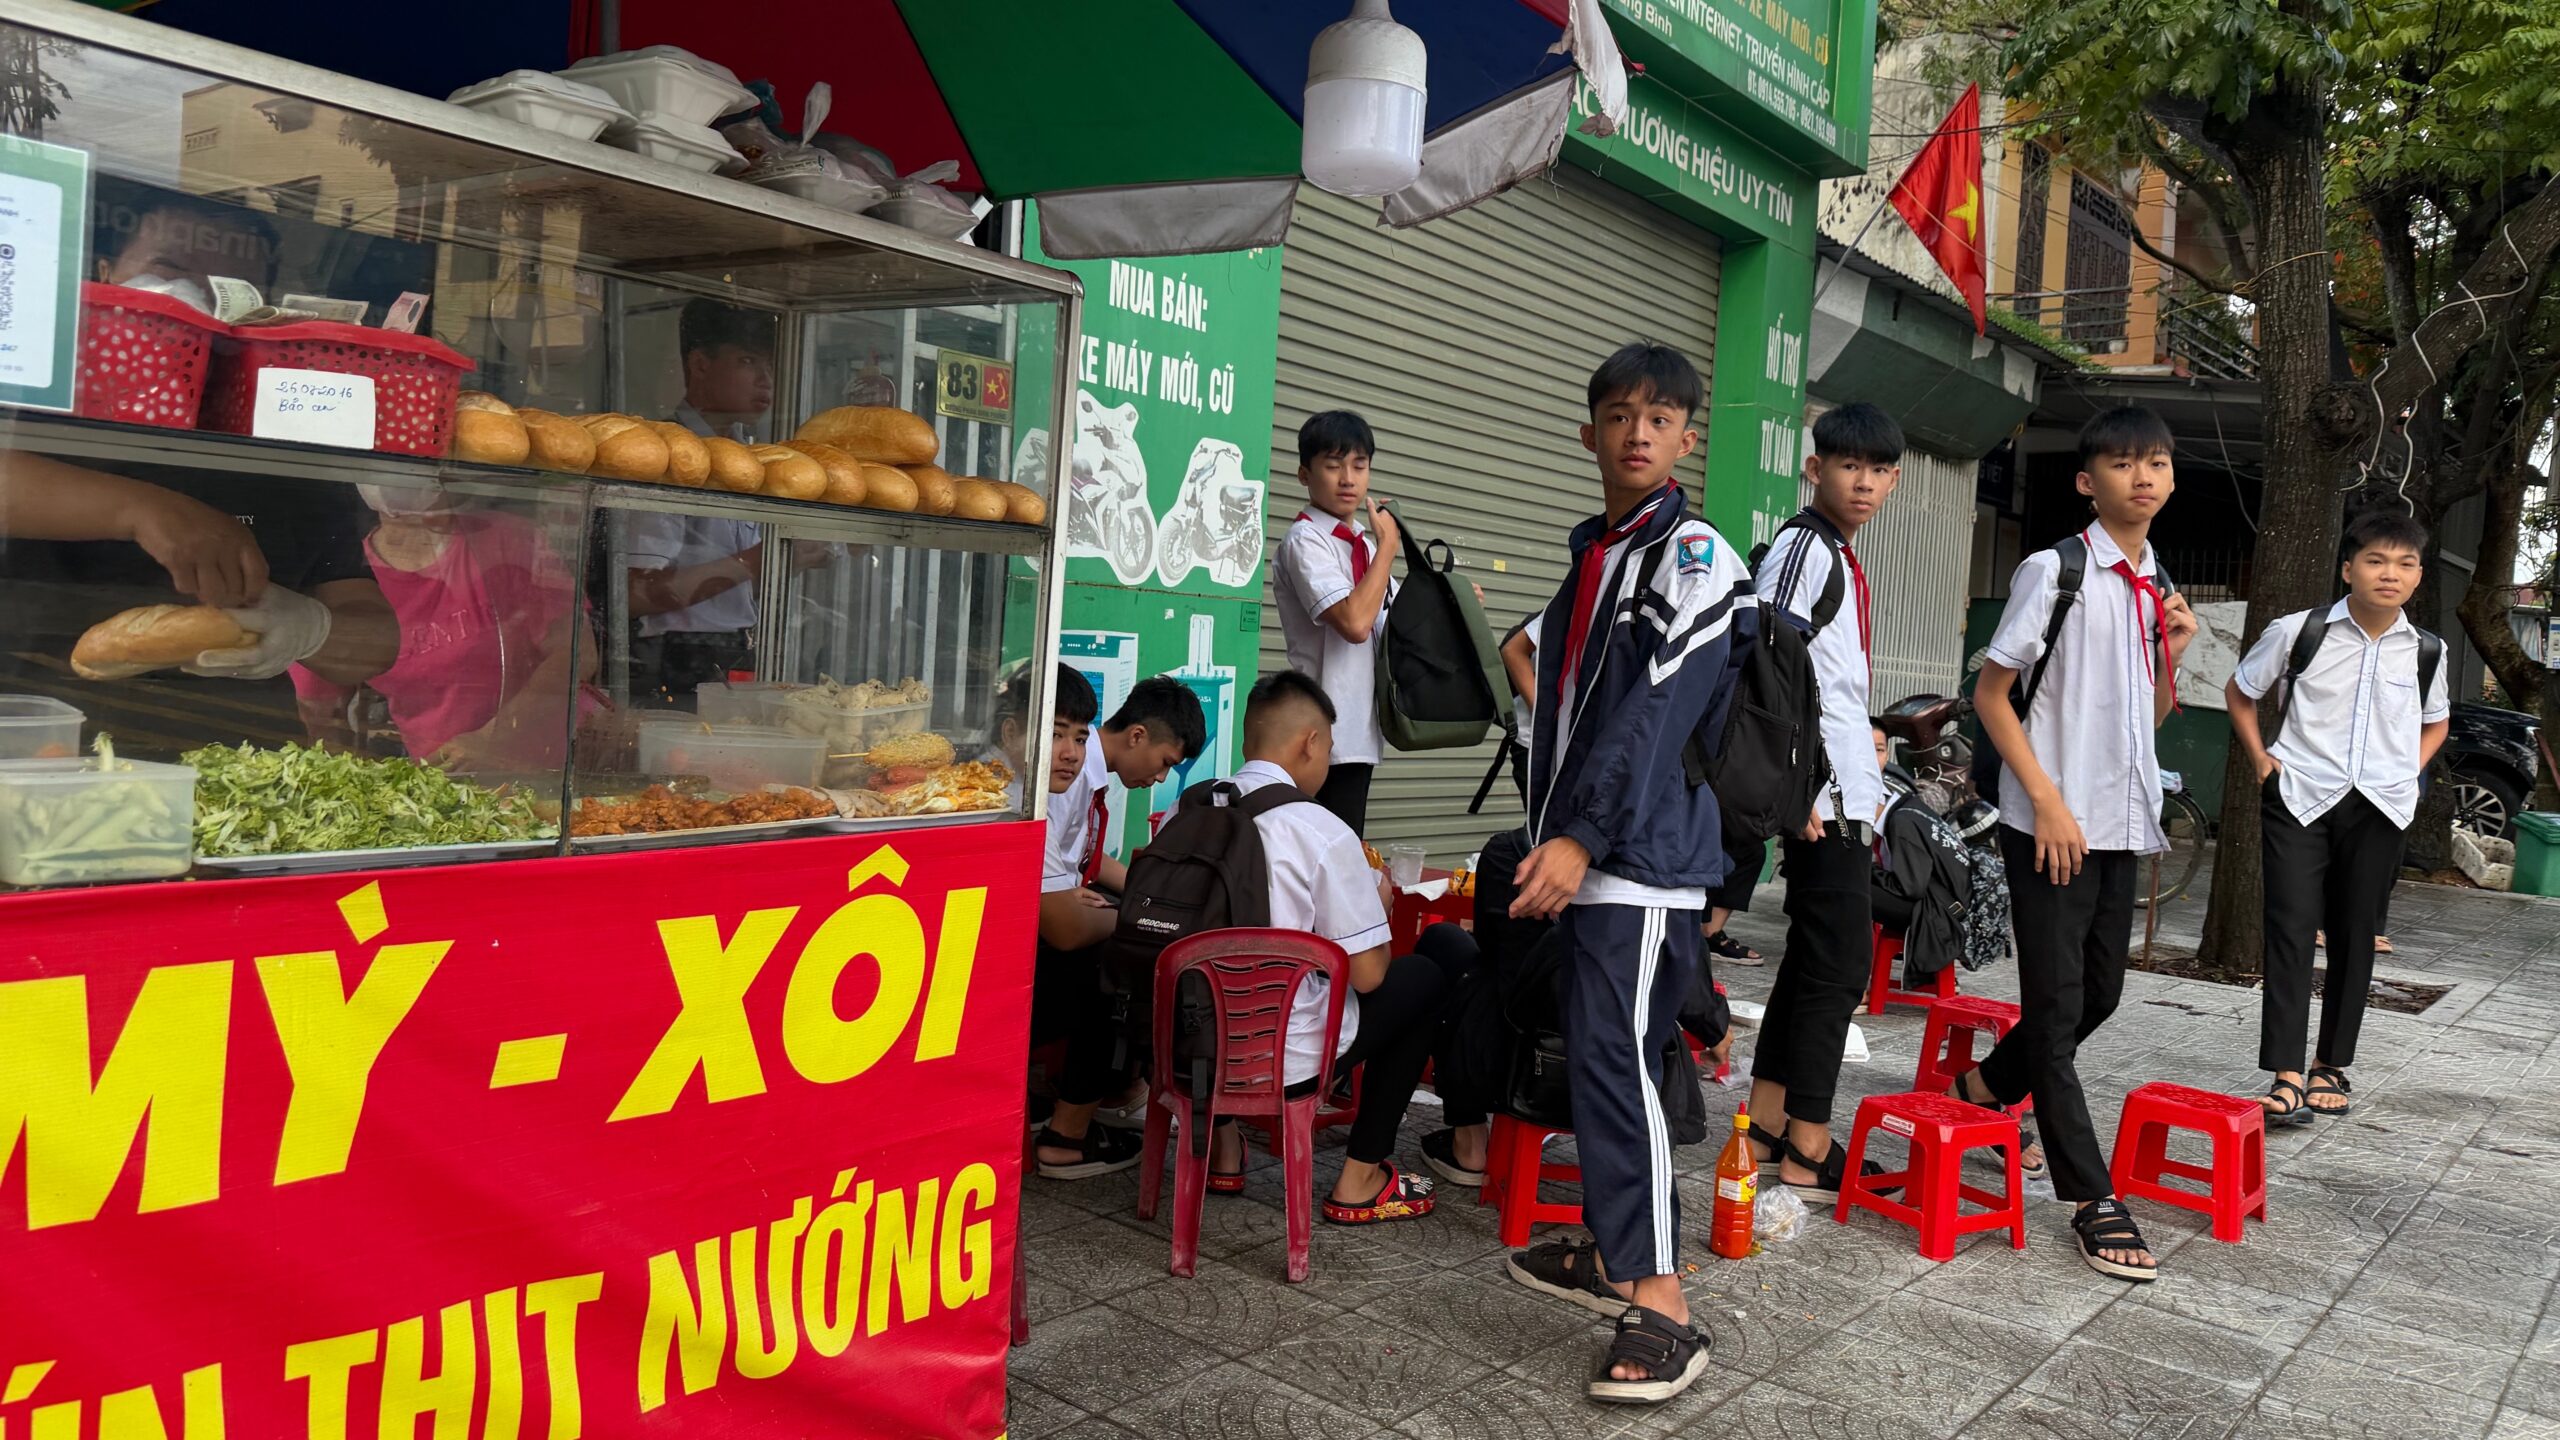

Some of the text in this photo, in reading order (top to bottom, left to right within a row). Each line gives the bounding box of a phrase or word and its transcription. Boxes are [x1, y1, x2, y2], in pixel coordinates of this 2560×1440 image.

[1645, 1, 1672, 37] Bình
[1765, 0, 1789, 38] MÁY
[1814, 32, 1829, 66] CŨ
[1787, 60, 1810, 99] HÌNH
[1811, 79, 1830, 109] CÁP
[1692, 143, 1735, 196] HIỆU
[1739, 169, 1764, 210] UY
[1766, 182, 1793, 227] TÍN
[1109, 260, 1208, 332] MUA BÁN:
[947, 362, 977, 400] 83
[1105, 339, 1153, 396] MÁY
[1160, 351, 1203, 414] MỚI,
[1209, 363, 1235, 415] CŨ
[1781, 333, 1802, 399] TRỢ
[1760, 416, 1795, 478] TƯ VẤN
[606, 844, 988, 1123] XÔI
[637, 1163, 997, 1414] NƯỚNG
